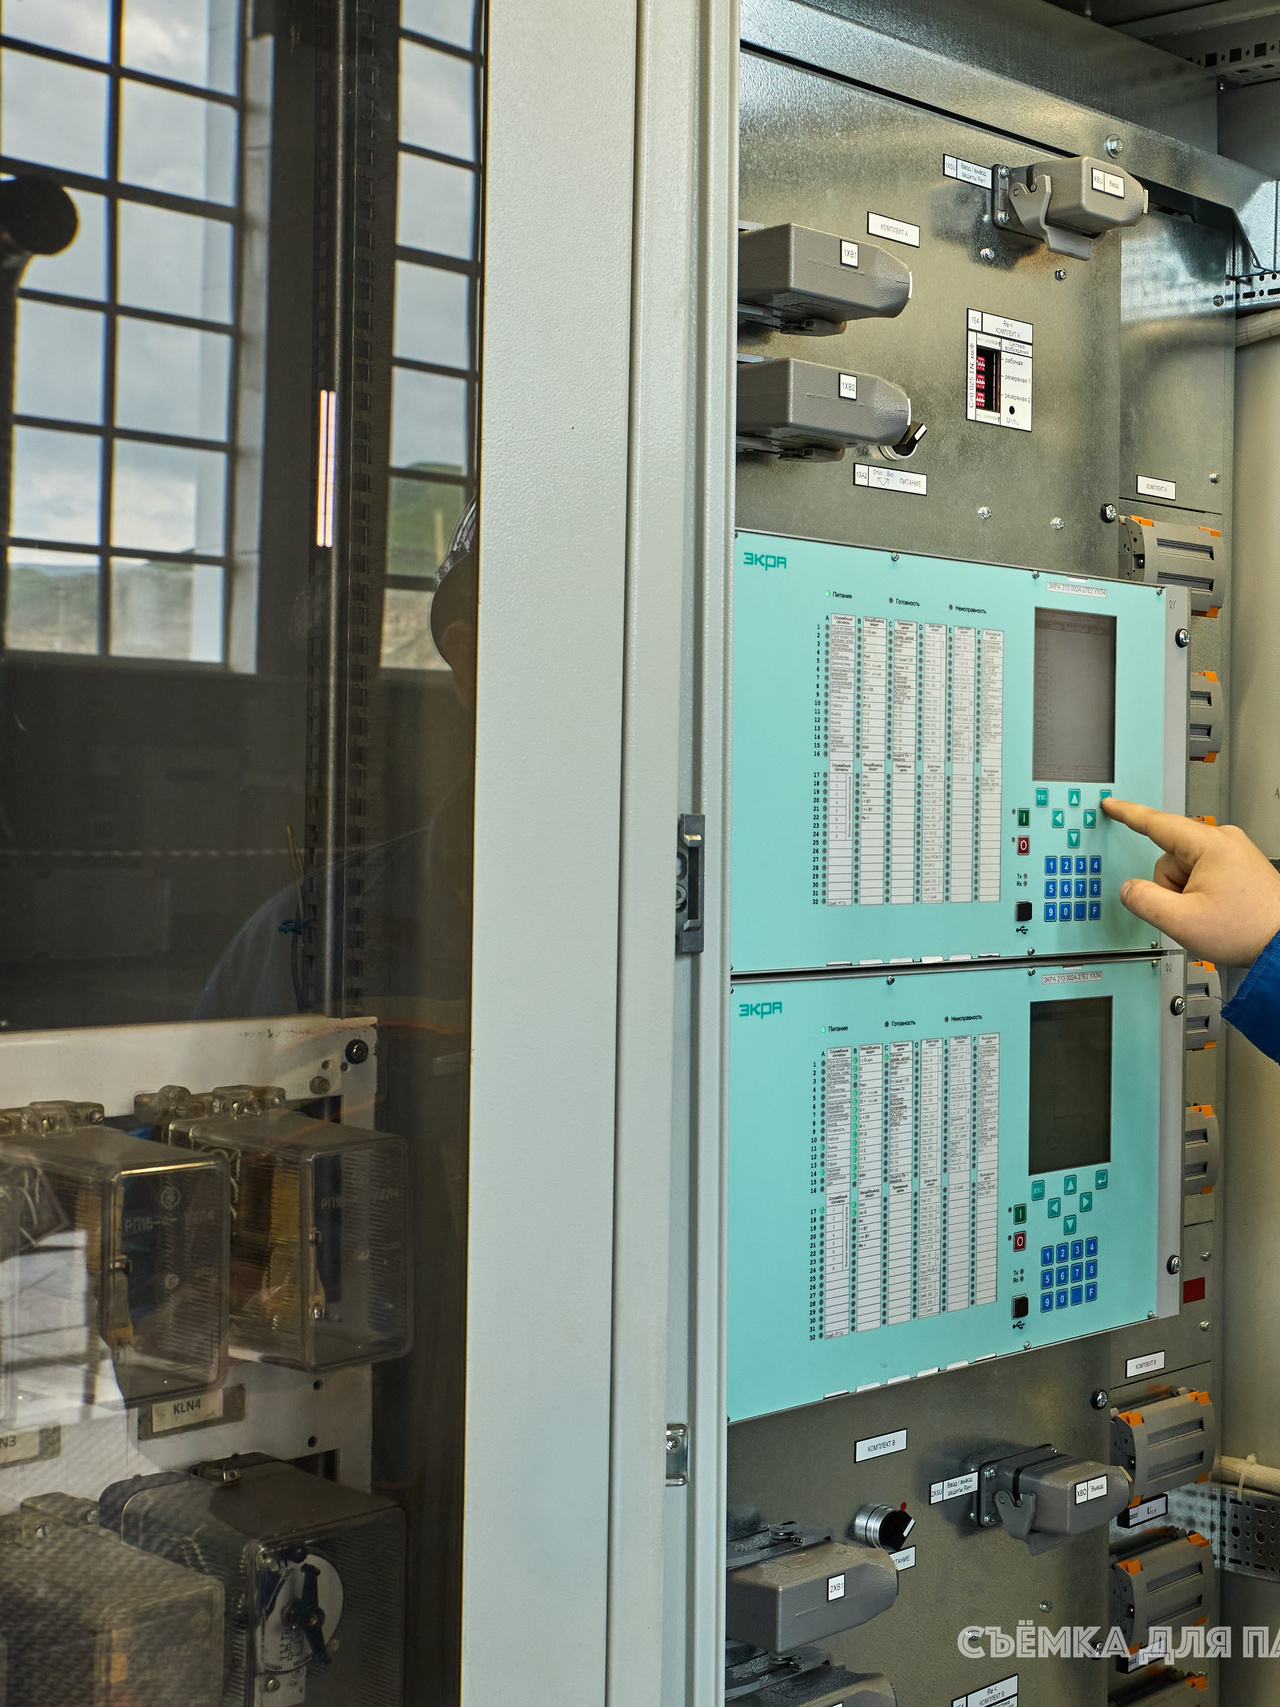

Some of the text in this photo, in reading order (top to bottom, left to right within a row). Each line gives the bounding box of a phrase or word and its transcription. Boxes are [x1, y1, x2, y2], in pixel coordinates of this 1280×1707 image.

[844, 249, 857, 258] 1XB1
[842, 382, 855, 392] 1XB2
[899, 478, 921, 487] ПИТАНИЕ
[743, 552, 787, 571] ЭКРА
[832, 591, 853, 600] Питание
[896, 598, 920, 607] Готовность
[955, 605, 987, 614] Неисправность
[739, 1002, 783, 1019] ЭКРА
[950, 1014, 983, 1022] Неисправность
[173, 1399, 202, 1415] KLN4
[867, 1441, 891, 1453] КОМПЛЕКТ
[830, 1583, 844, 1593] 2XB1
